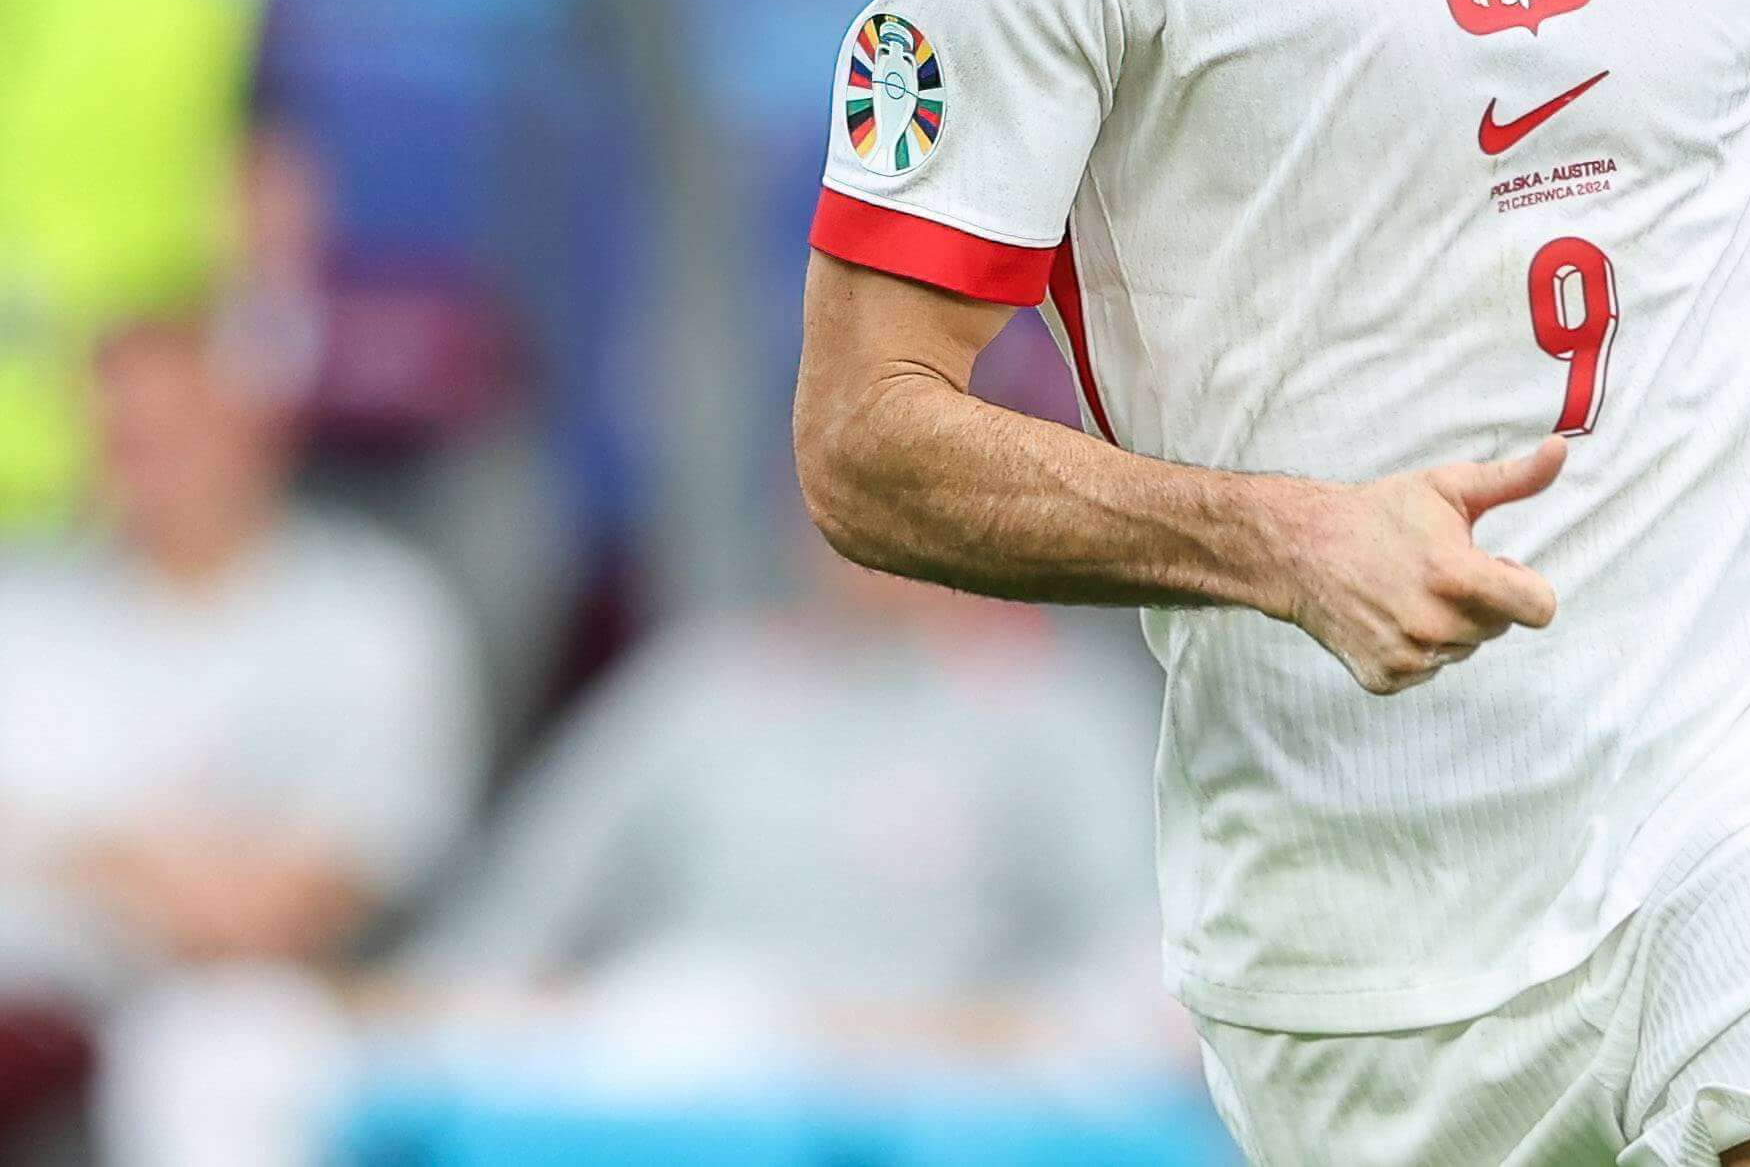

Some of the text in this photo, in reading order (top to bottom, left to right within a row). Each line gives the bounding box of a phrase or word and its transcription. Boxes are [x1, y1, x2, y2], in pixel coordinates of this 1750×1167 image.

[1498, 179, 1610, 213] 21 CZERWCA 2024
[1528, 236, 1620, 438] 9
